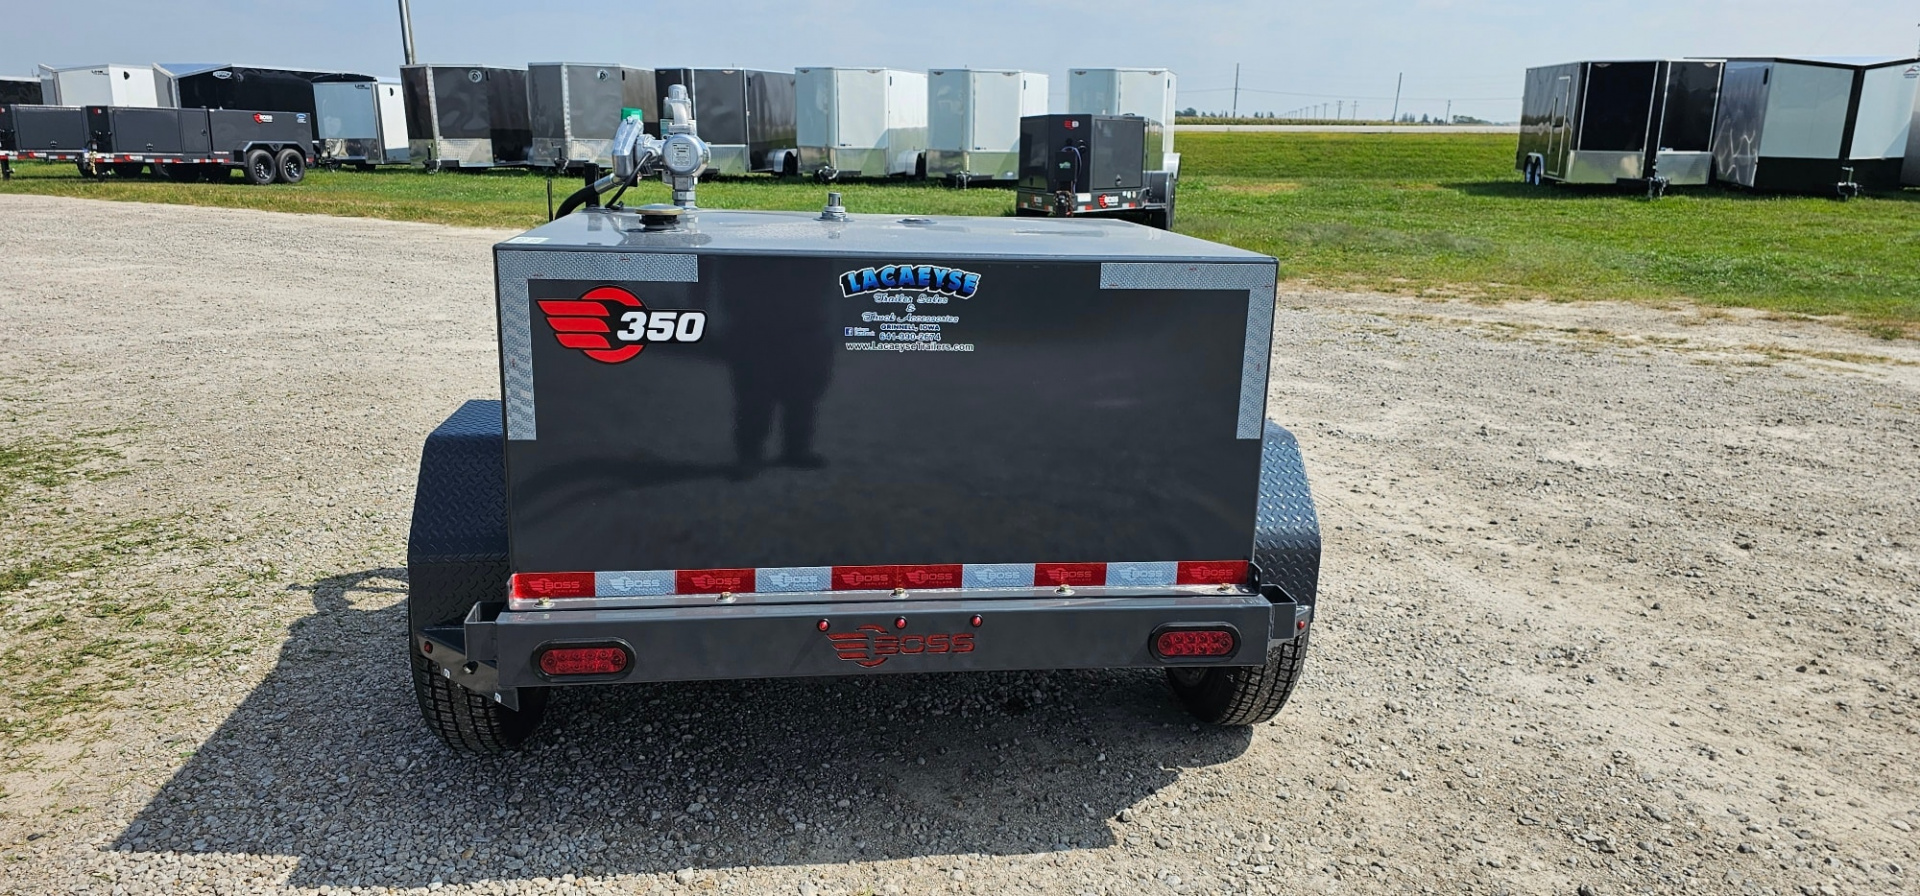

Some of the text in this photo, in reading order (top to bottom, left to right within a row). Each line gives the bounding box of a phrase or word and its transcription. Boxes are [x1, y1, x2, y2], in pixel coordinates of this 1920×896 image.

[842, 265, 980, 296] LACAEYSE
[917, 293, 949, 304] Sales
[905, 303, 916, 312] &
[617, 311, 705, 342] 350
[919, 323, 941, 331] IOWA
[845, 341, 975, 353] www.LacaeyseTrailers.com
[855, 574, 889, 582] BOSS
[988, 571, 1020, 579] BOSS
[1061, 570, 1092, 578] BOSS
[544, 581, 580, 589] BOSS
[625, 580, 660, 588] BOSS
[707, 577, 741, 585] BOSS
[874, 632, 975, 655] BOSS
